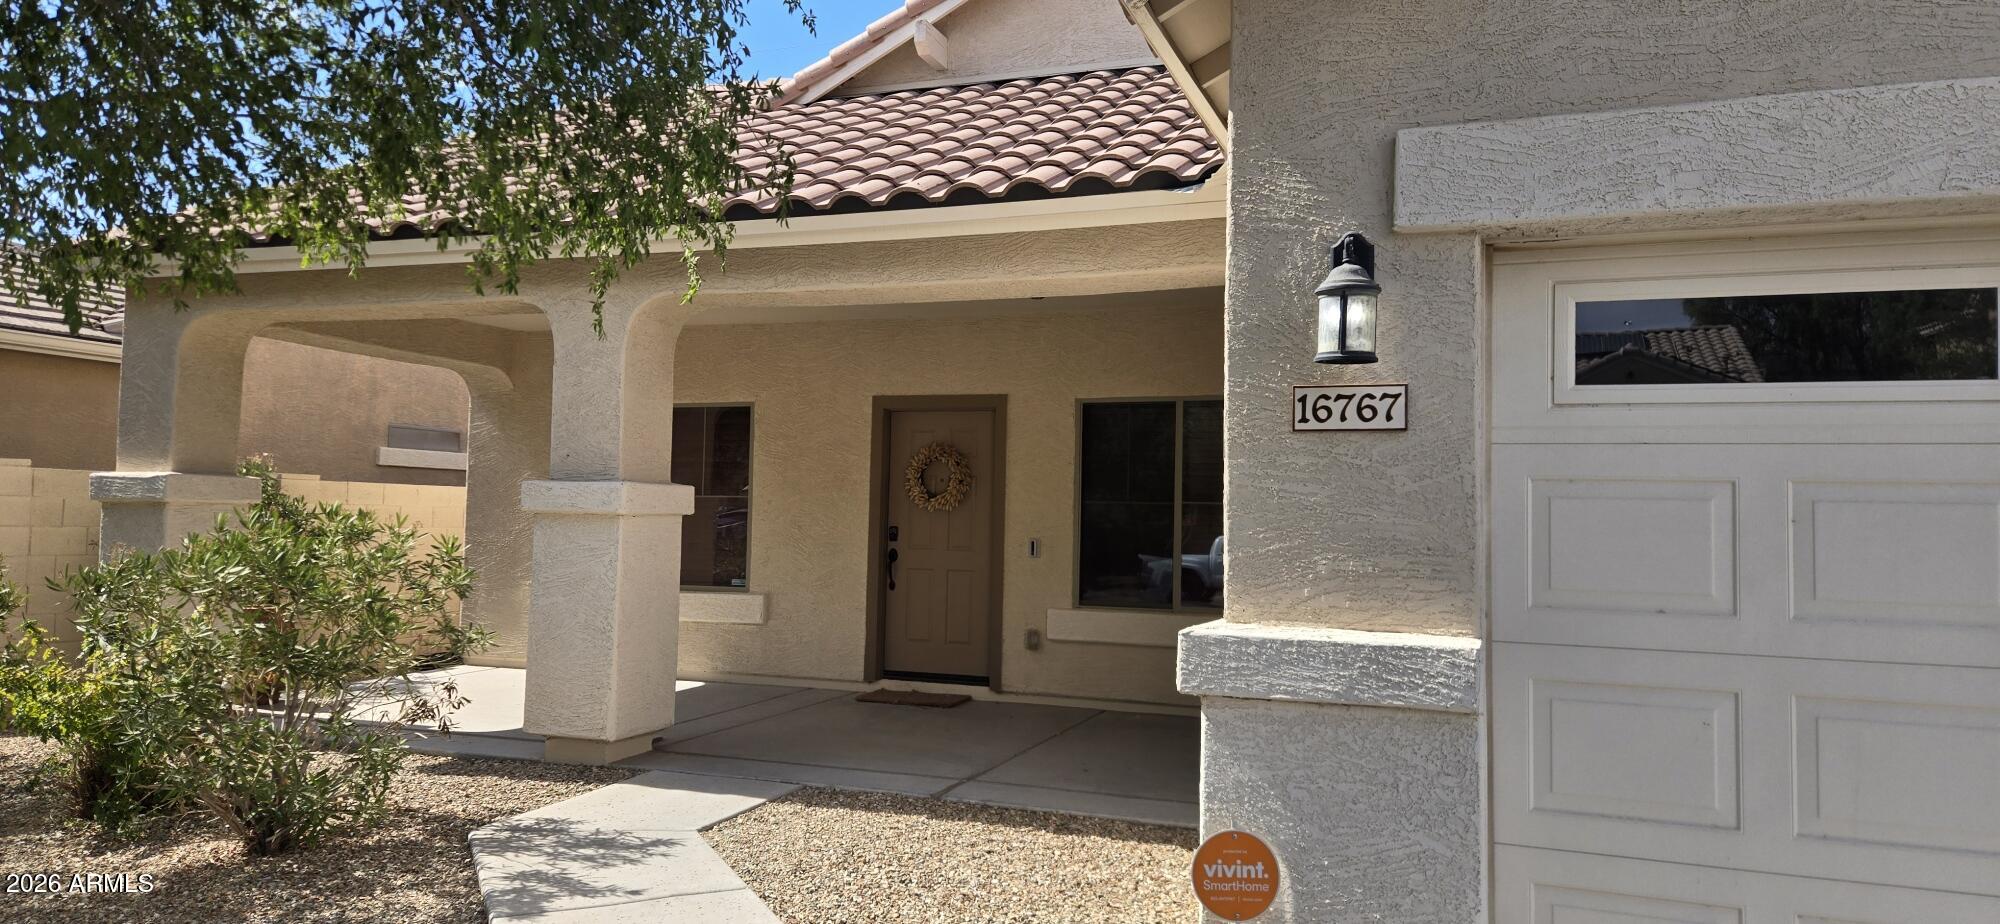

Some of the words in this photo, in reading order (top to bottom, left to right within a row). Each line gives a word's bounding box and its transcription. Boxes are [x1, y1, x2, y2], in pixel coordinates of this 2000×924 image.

[1297, 392, 1402, 424] 16767
[1203, 859, 1269, 879] vivint.
[1203, 880, 1270, 892] SmartHome
